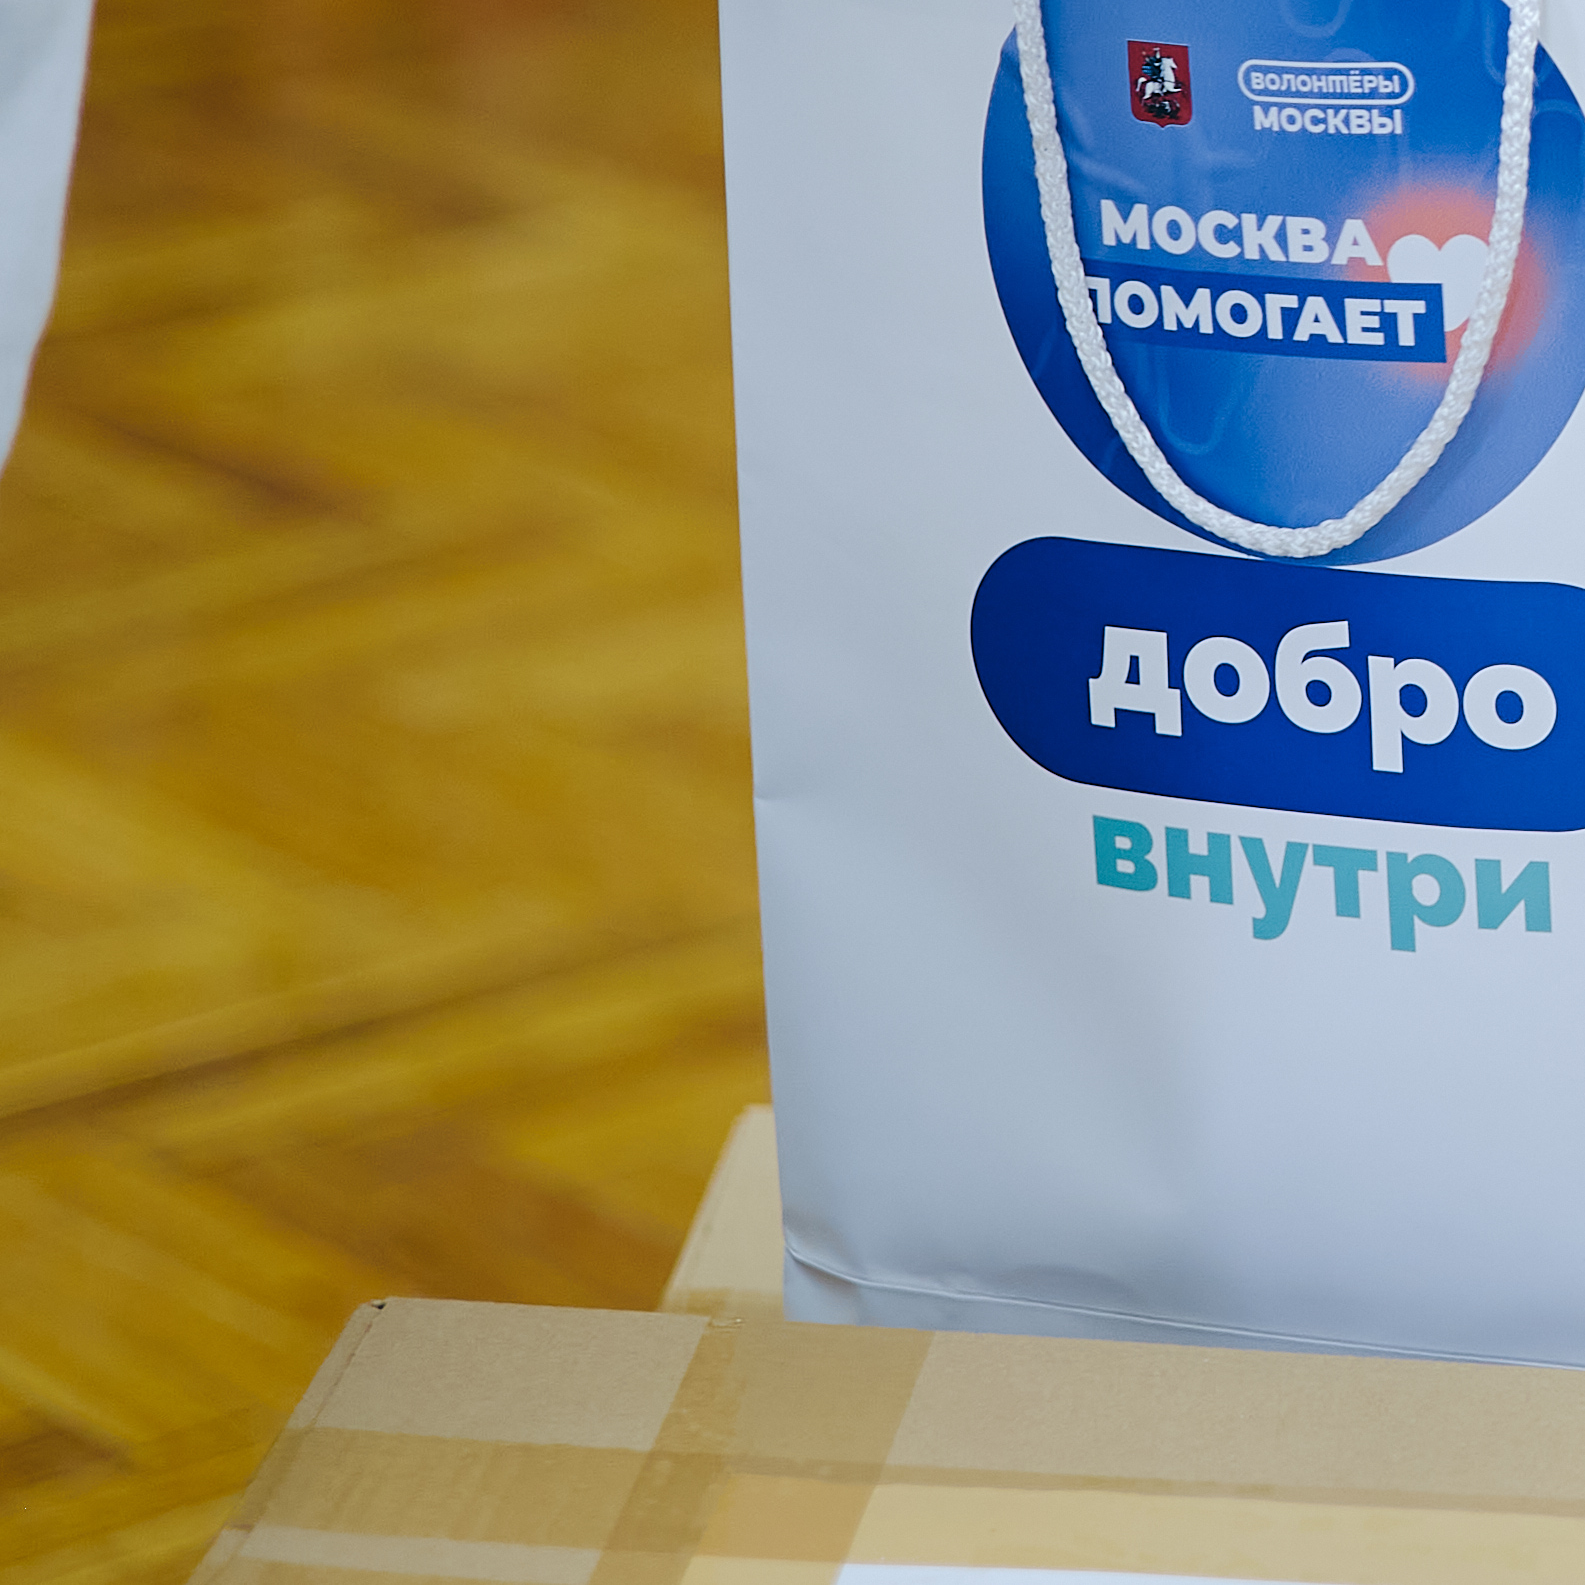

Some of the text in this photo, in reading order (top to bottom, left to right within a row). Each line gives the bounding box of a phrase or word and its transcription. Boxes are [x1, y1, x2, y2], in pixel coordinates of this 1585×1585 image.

[1252, 105, 1403, 135] МОСКВЫ
[1099, 199, 1384, 267] МОСКВА
[1088, 620, 1557, 774] добро
[1092, 815, 1552, 952] внутри
